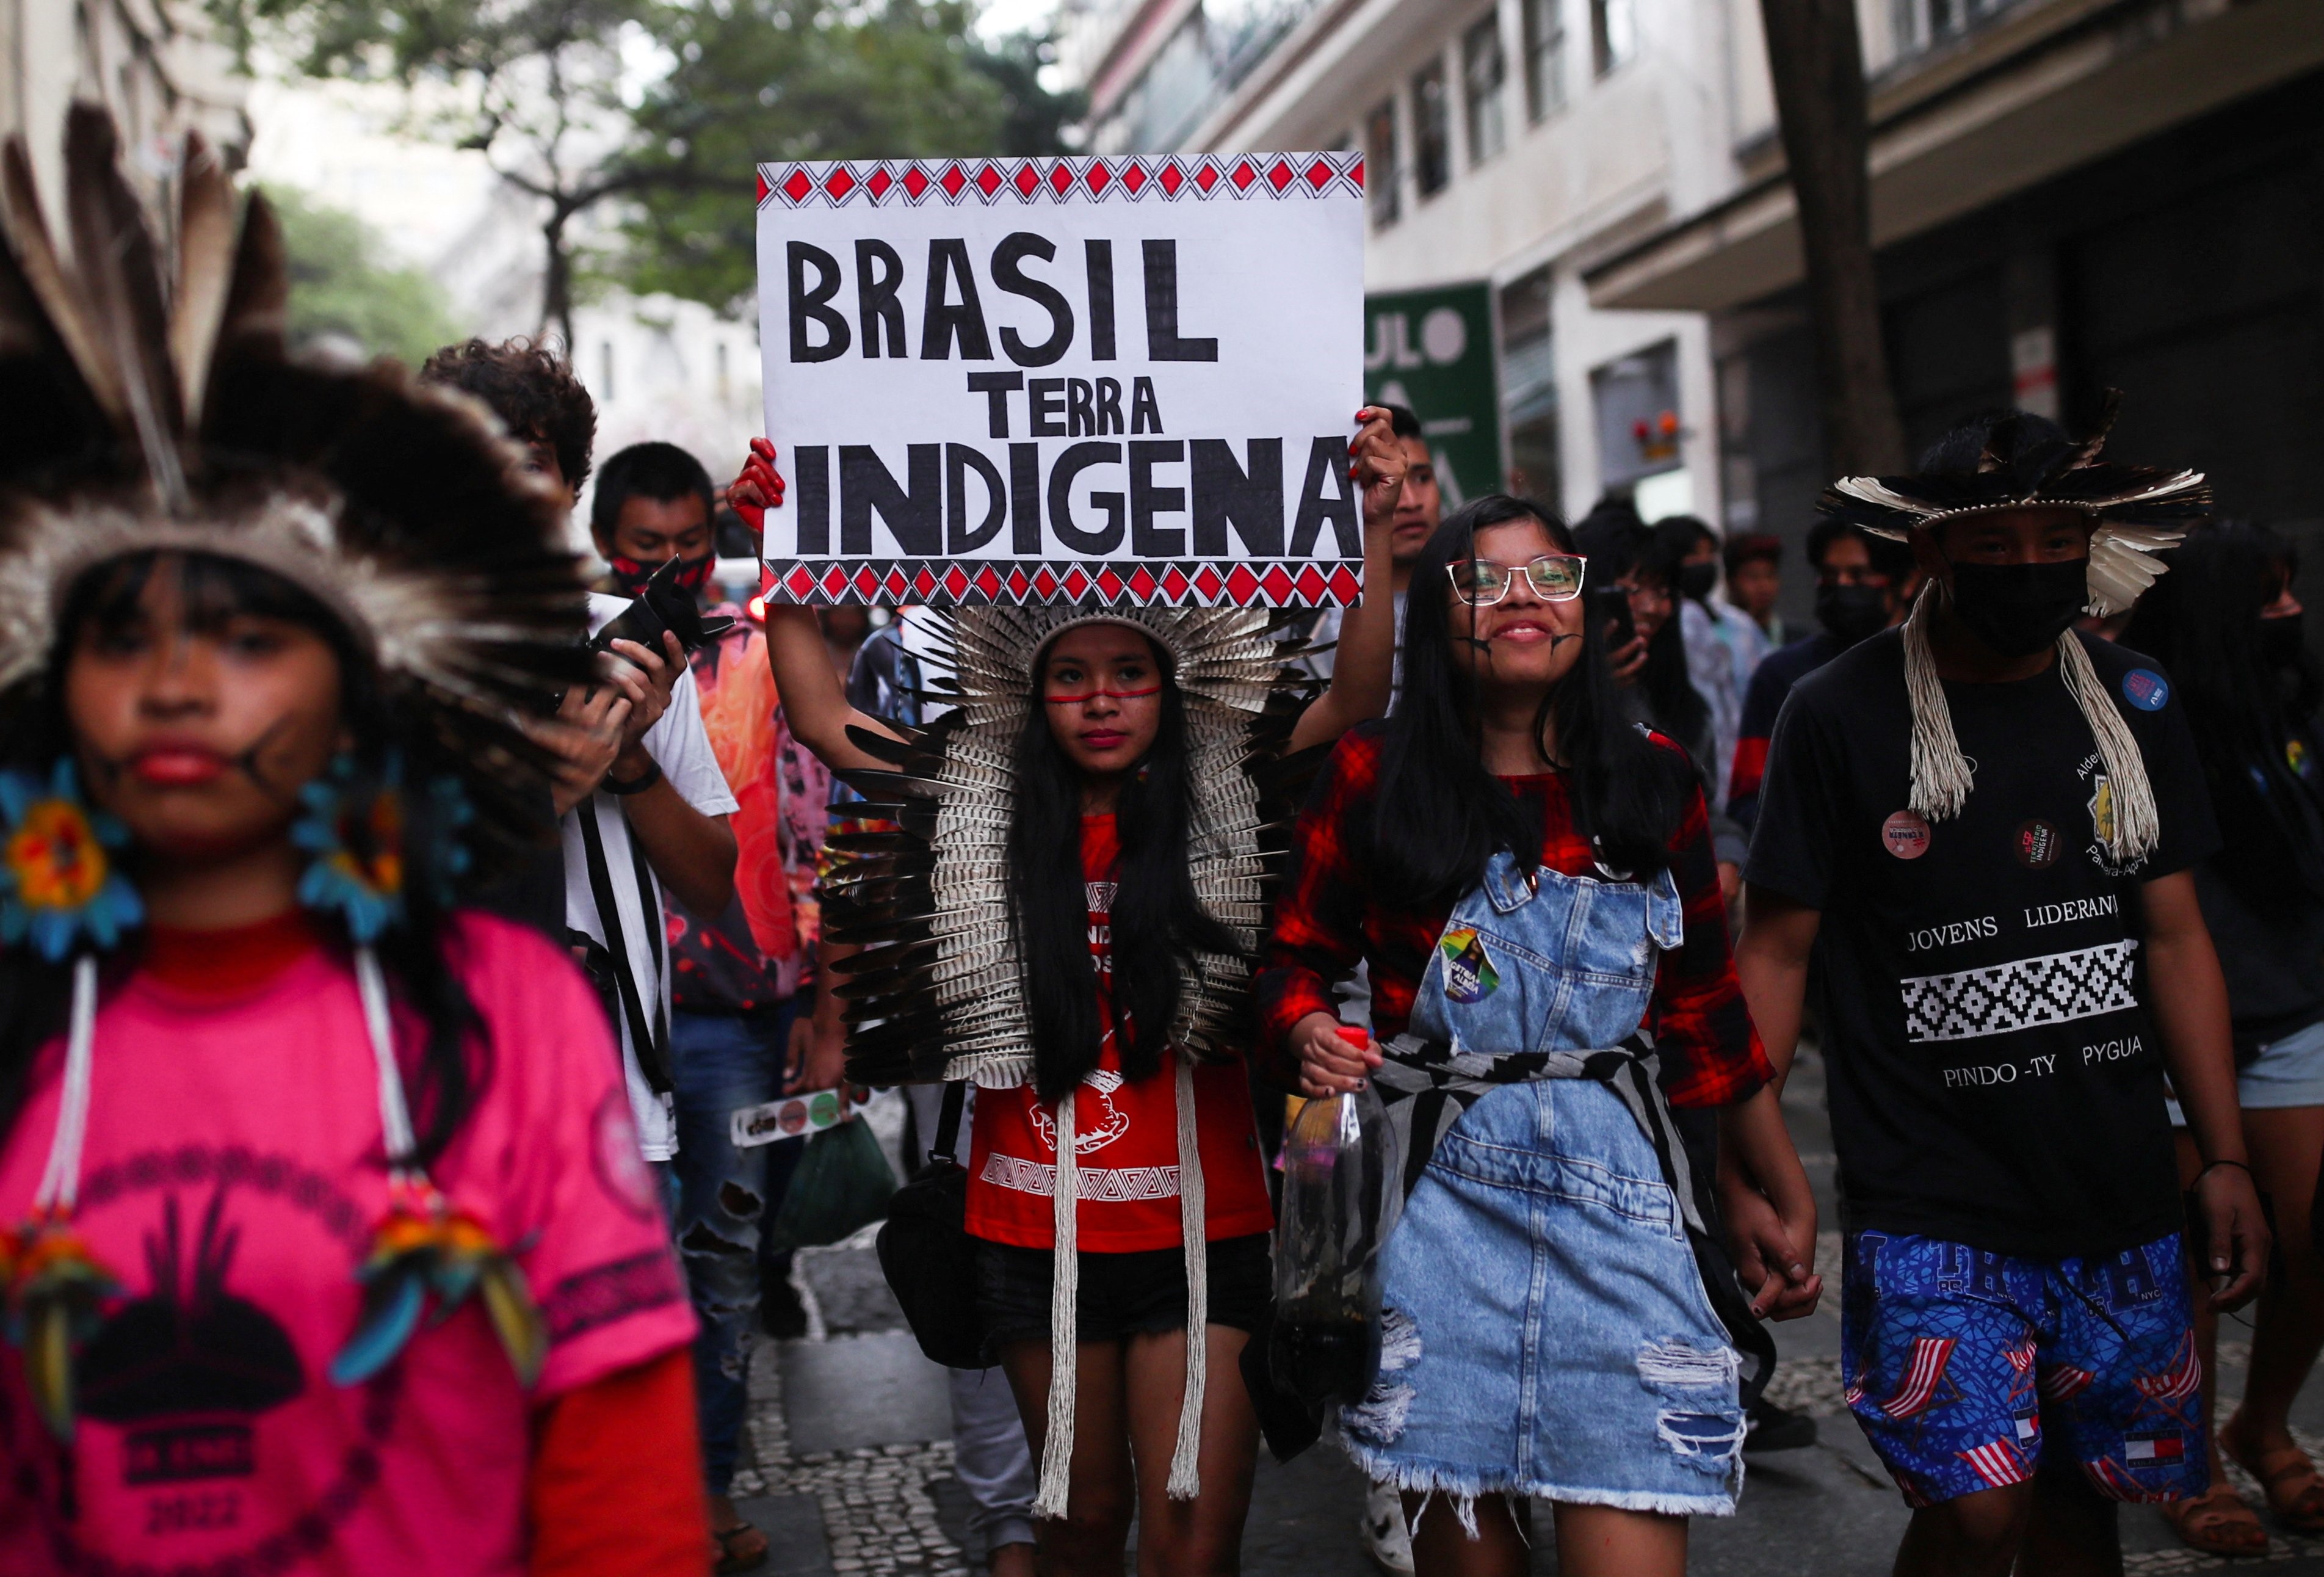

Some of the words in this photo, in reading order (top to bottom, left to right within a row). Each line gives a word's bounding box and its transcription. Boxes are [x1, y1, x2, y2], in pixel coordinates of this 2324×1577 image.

[787, 232, 1218, 368] BRASIL
[967, 371, 1164, 438] TERRA
[794, 435, 1363, 559] INDIGENA
[1908, 916, 1998, 951] JOVENS
[1944, 1063, 2017, 1087] PINDO
[2082, 1035, 2142, 1065] PYGUA
[2141, 1289, 2162, 1300] NYC
